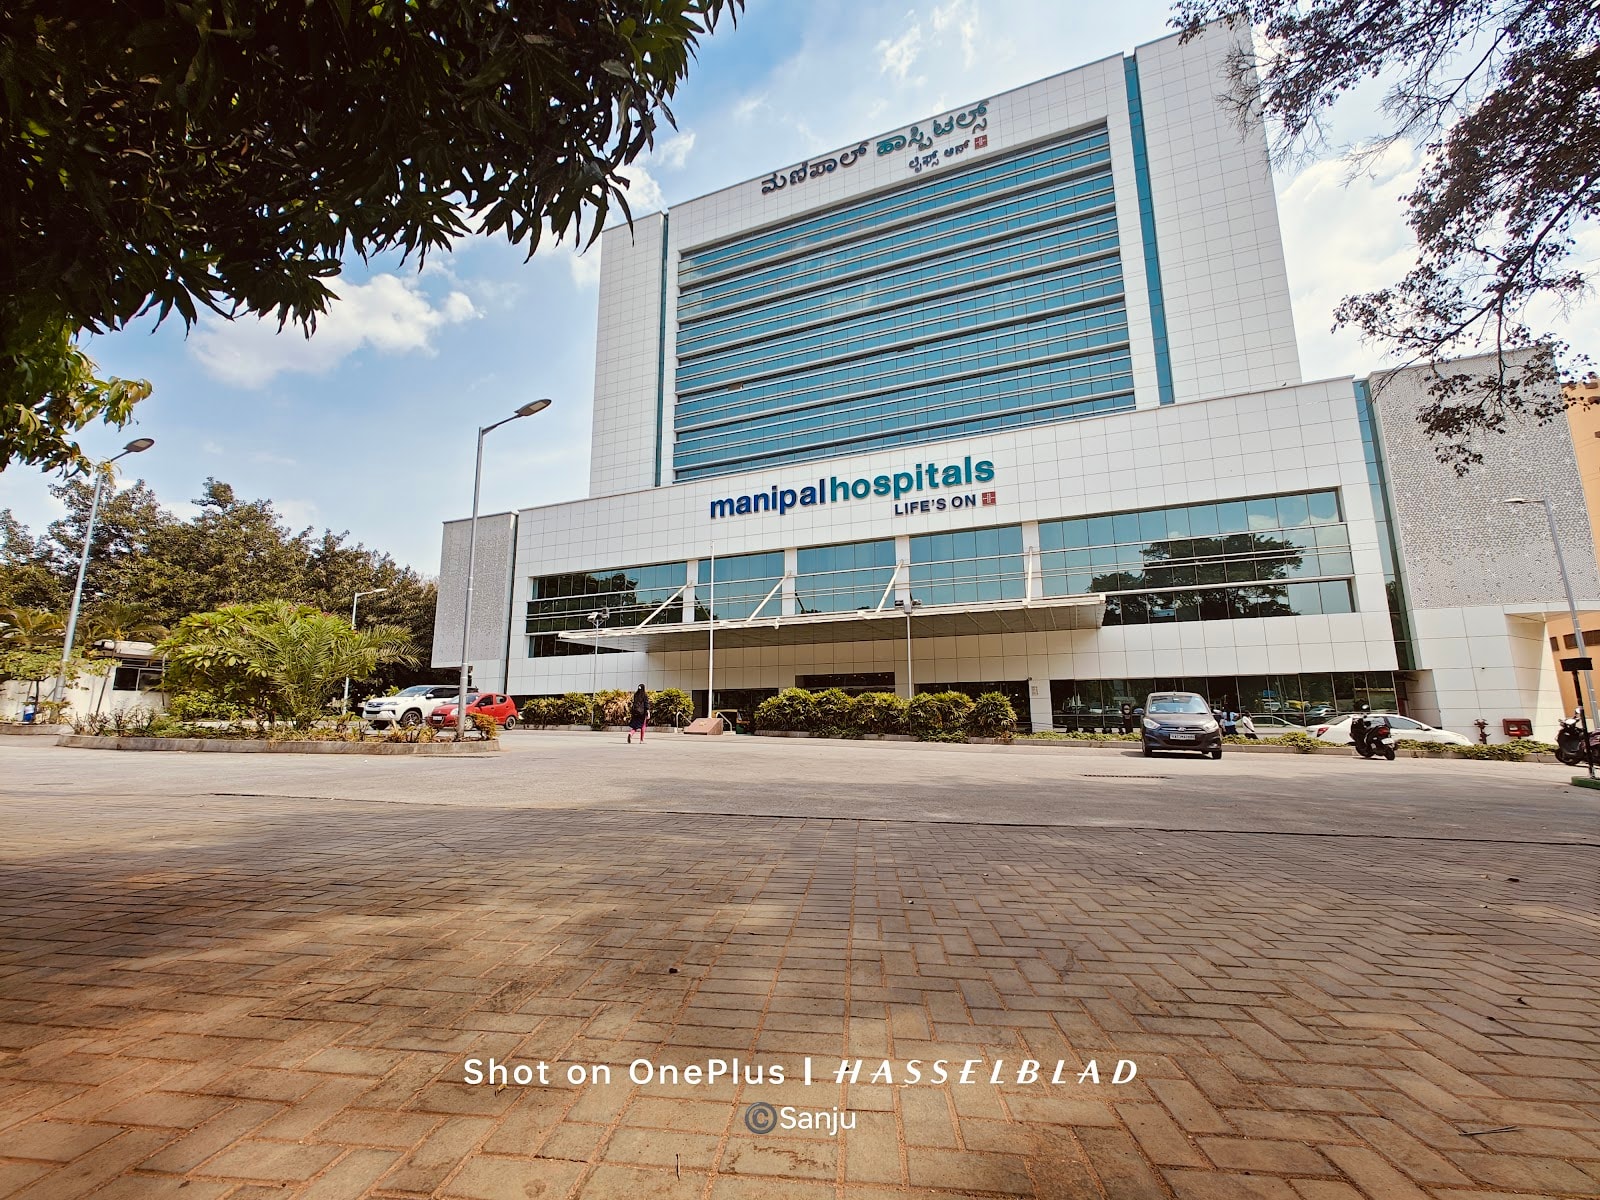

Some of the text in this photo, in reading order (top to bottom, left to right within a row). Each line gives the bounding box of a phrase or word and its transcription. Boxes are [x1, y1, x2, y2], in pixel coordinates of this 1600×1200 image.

[761, 140, 869, 195] ಮಣಿಪಾಲ್
[894, 494, 976, 516] LIFE'S ON
